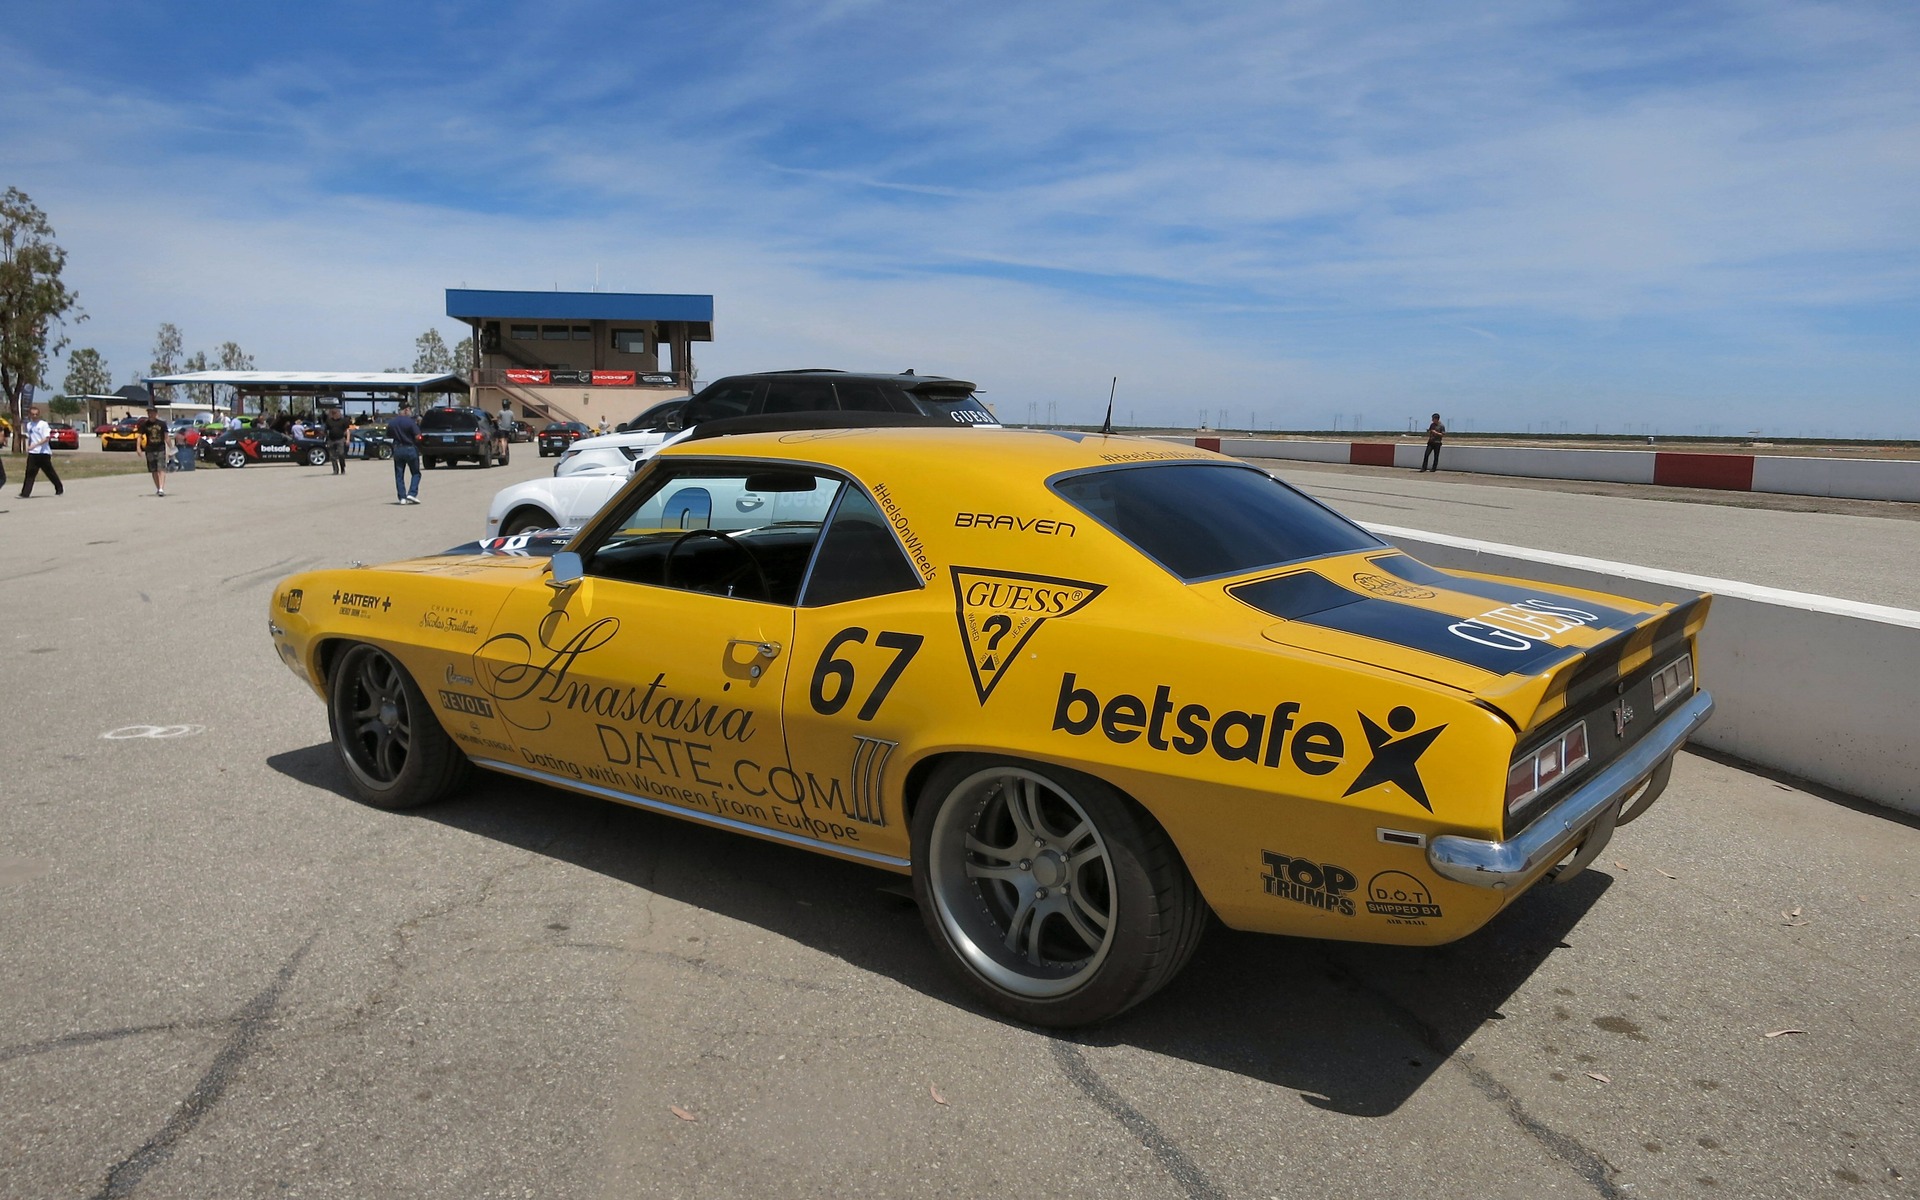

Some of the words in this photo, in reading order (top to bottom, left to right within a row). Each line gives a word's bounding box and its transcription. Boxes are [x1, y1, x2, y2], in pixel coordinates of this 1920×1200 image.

[950, 410, 993, 424] GUESS
[260, 444, 291, 453] betsafe
[872, 482, 937, 582] #HeelsOnWheels
[954, 512, 1076, 538] BRAVEN
[341, 592, 381, 609] BATTERY
[430, 604, 474, 617] CHAMPAGNE
[967, 612, 980, 642] WASHED
[1011, 616, 1031, 639] JEANS
[1447, 598, 1599, 651] GUESS
[472, 609, 756, 743] Anastasia
[808, 626, 925, 722] 67
[439, 691, 492, 717] REVOLT
[1051, 671, 1345, 776] betsafe
[594, 723, 848, 815] DATE.COM
[520, 746, 583, 780] Dating
[583, 764, 626, 787] with
[626, 771, 709, 808] Women
[711, 790, 768, 820] from
[771, 805, 860, 842] Europe
[1261, 849, 1359, 896] TOP
[1261, 872, 1357, 918] TRUMPS
[1368, 903, 1419, 916] SHIPPED
[1421, 906, 1439, 916] BY
[1386, 917, 1403, 925] AIR
[1404, 918, 1428, 927] MAIL
